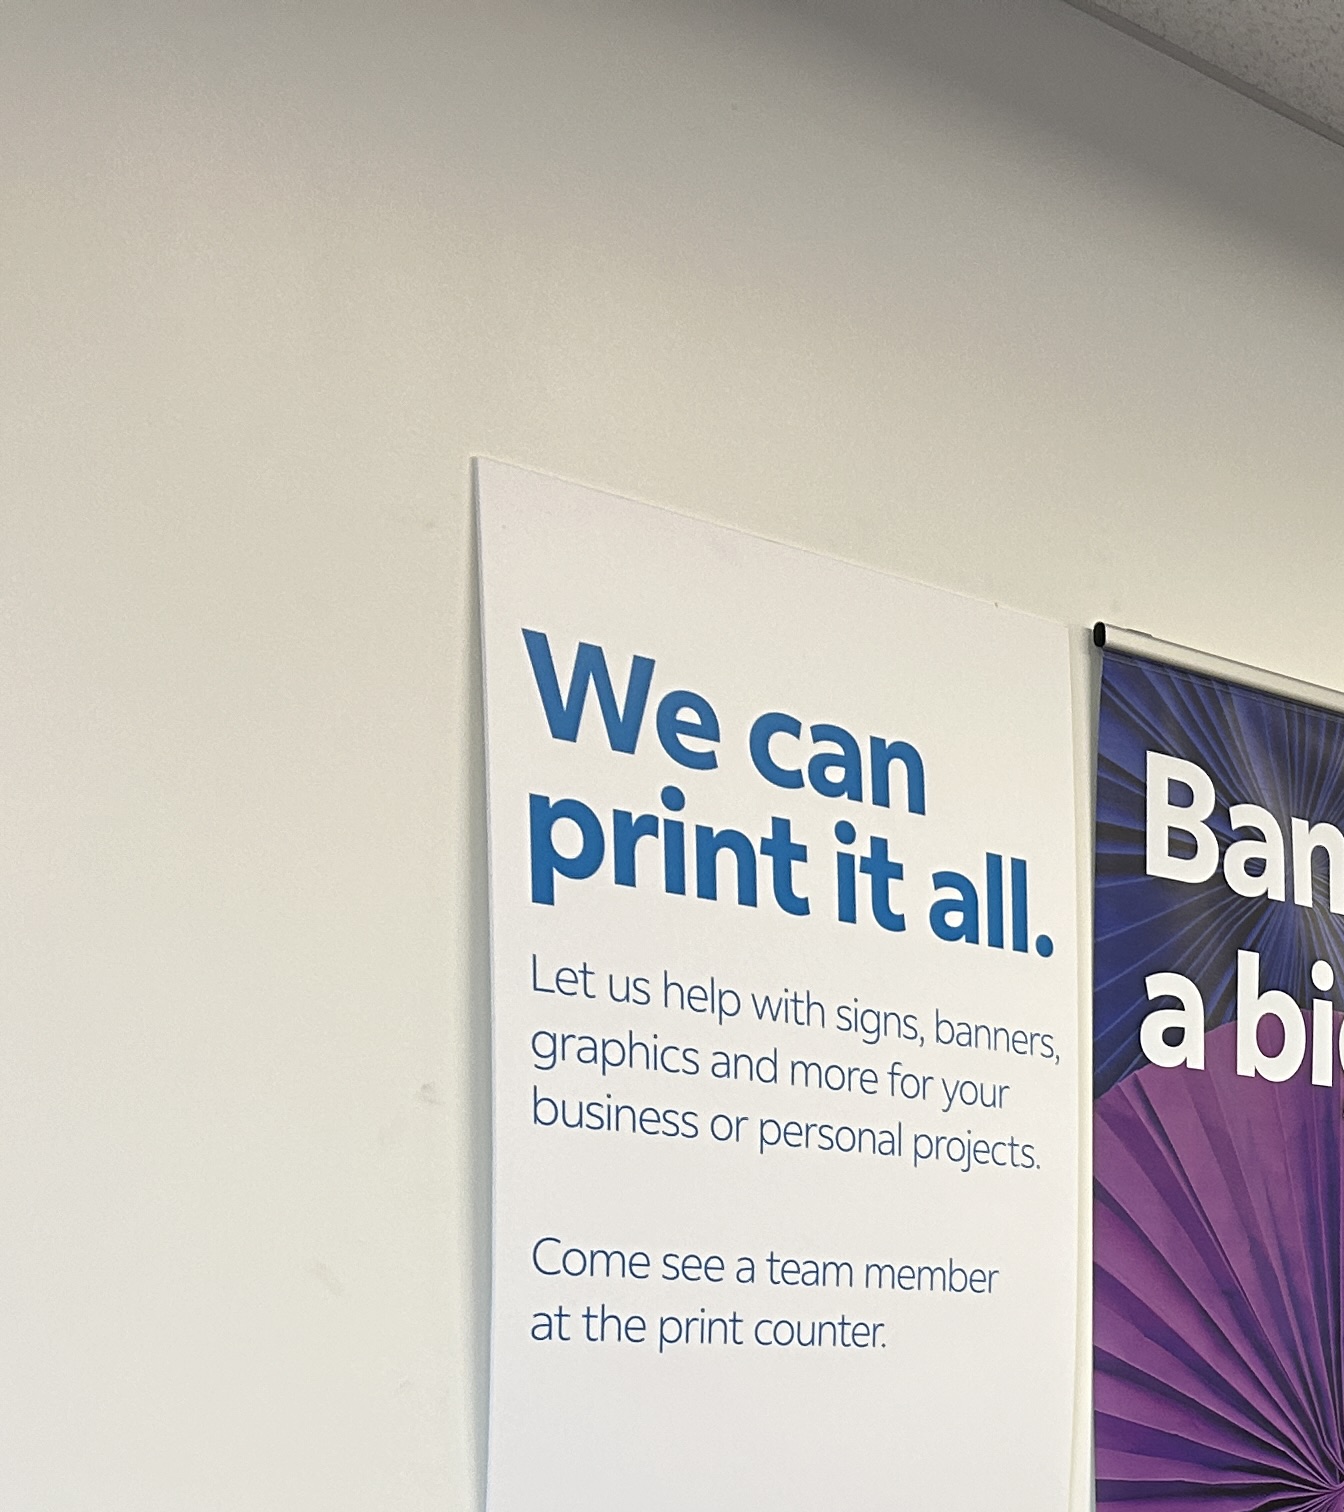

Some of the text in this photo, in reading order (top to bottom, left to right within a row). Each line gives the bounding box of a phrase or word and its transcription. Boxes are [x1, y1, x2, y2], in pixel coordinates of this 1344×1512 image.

[521, 627, 926, 816] We can
[528, 785, 1054, 958] print it all.
[533, 954, 1061, 1065] Let us help with signs, banners,
[1138, 969, 1205, 1071] a
[531, 1030, 1011, 1113] graphics and more for your
[533, 1085, 1041, 1172] business or personal projects.
[532, 1236, 1000, 1294] Come see a team member
[530, 1303, 887, 1353] at the print counter.
